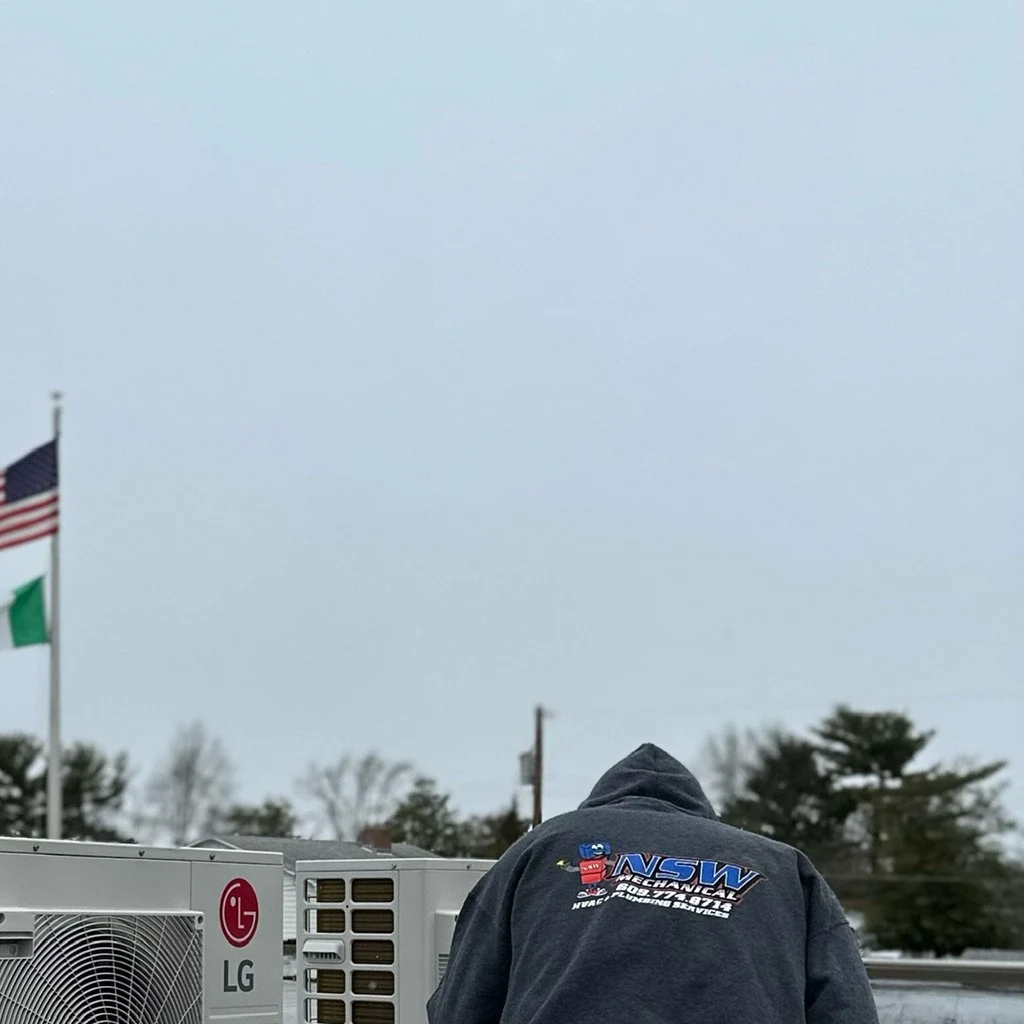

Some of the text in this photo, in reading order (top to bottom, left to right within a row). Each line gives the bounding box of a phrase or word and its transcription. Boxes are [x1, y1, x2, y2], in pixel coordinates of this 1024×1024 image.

[612, 853, 759, 891] NSW
[616, 873, 737, 901] MECHANICAL
[571, 897, 603, 910] HVAC
[610, 891, 672, 908] PLUMBING
[672, 901, 730, 919] SERVICES
[616, 882, 733, 912] 609.774.8714
[223, 959, 254, 993] LG
